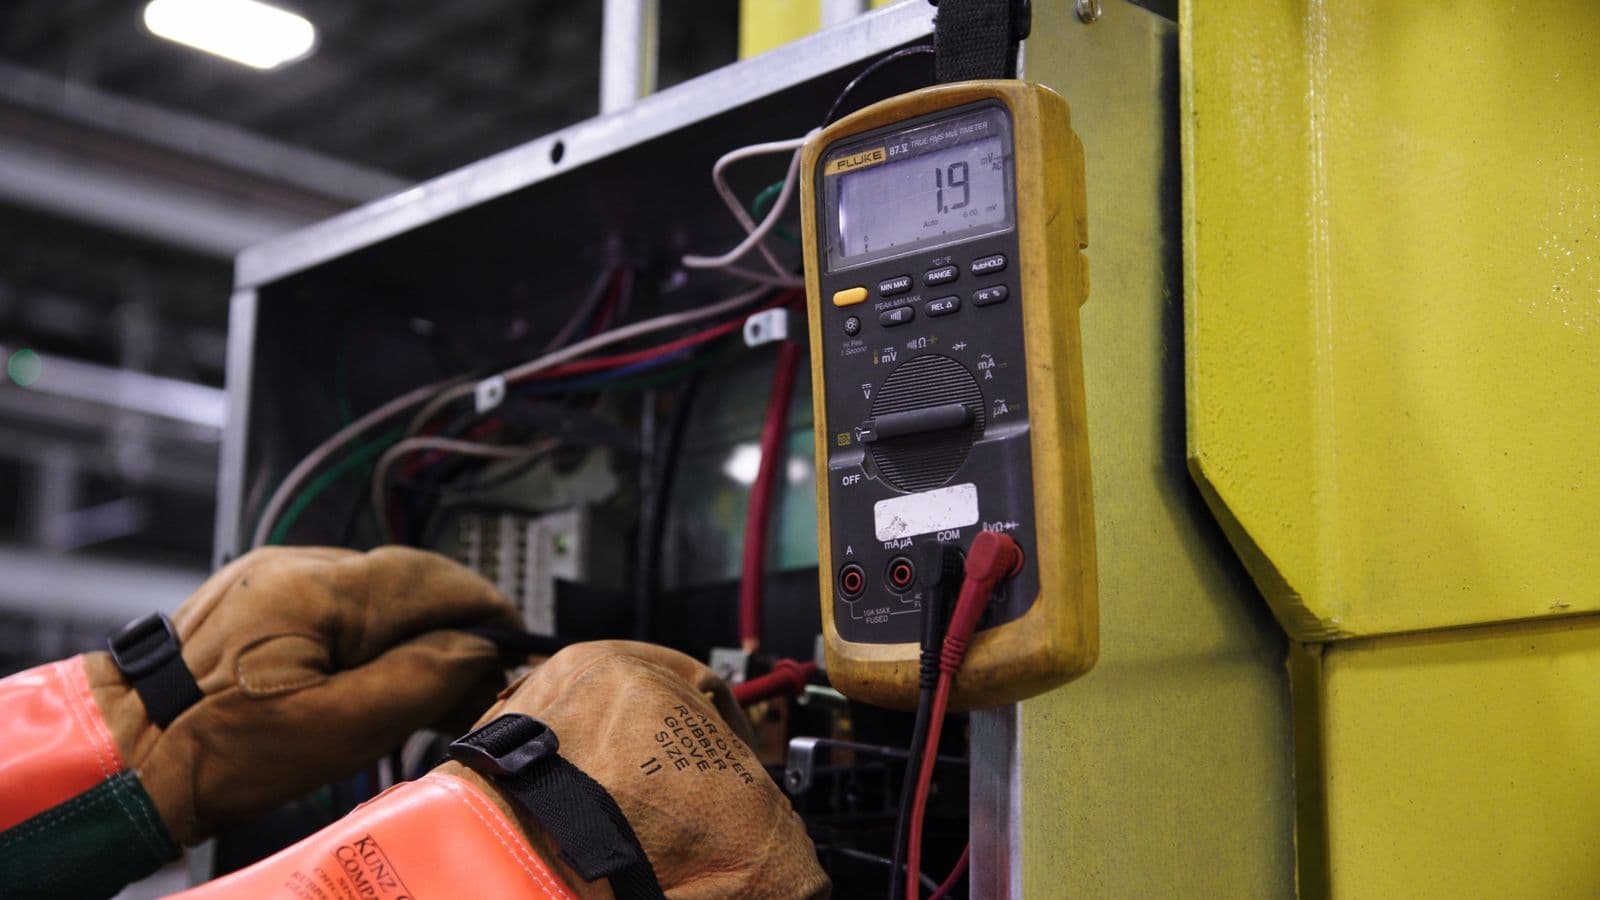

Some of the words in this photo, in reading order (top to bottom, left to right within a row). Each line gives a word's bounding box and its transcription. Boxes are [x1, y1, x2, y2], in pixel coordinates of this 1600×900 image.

[837, 151, 882, 170] FLUKE
[911, 138, 929, 147] TRUE
[929, 133, 944, 144] RMS
[945, 121, 988, 138] MULTIMETER
[935, 160, 970, 214] 1.9
[923, 219, 939, 228] Auto
[972, 258, 1003, 271] AutoHOLD
[928, 269, 952, 281] RANGE
[880, 283, 893, 292] MIN
[893, 279, 908, 289] MAX
[875, 302, 892, 311] PEAK
[893, 298, 906, 307] MIN
[906, 294, 921, 304] MAX
[979, 292, 989, 300] Hz
[931, 302, 944, 312] REL
[881, 351, 897, 364] mV
[978, 357, 995, 370] mA
[984, 369, 993, 380] A
[863, 389, 871, 400] V
[842, 474, 861, 486] OFF
[937, 530, 960, 542] COM
[846, 545, 853, 555] A
[884, 539, 899, 550] mA
[865, 615, 888, 624] FUSED
[663, 716, 711, 772] GLOVE
[673, 704, 727, 771] RUBBER
[655, 731, 690, 771] SIZE
[640, 757, 662, 776] 11
[716, 738, 754, 784] OVER
[353, 834, 397, 893] KUNZ
[335, 845, 379, 900] COMP
